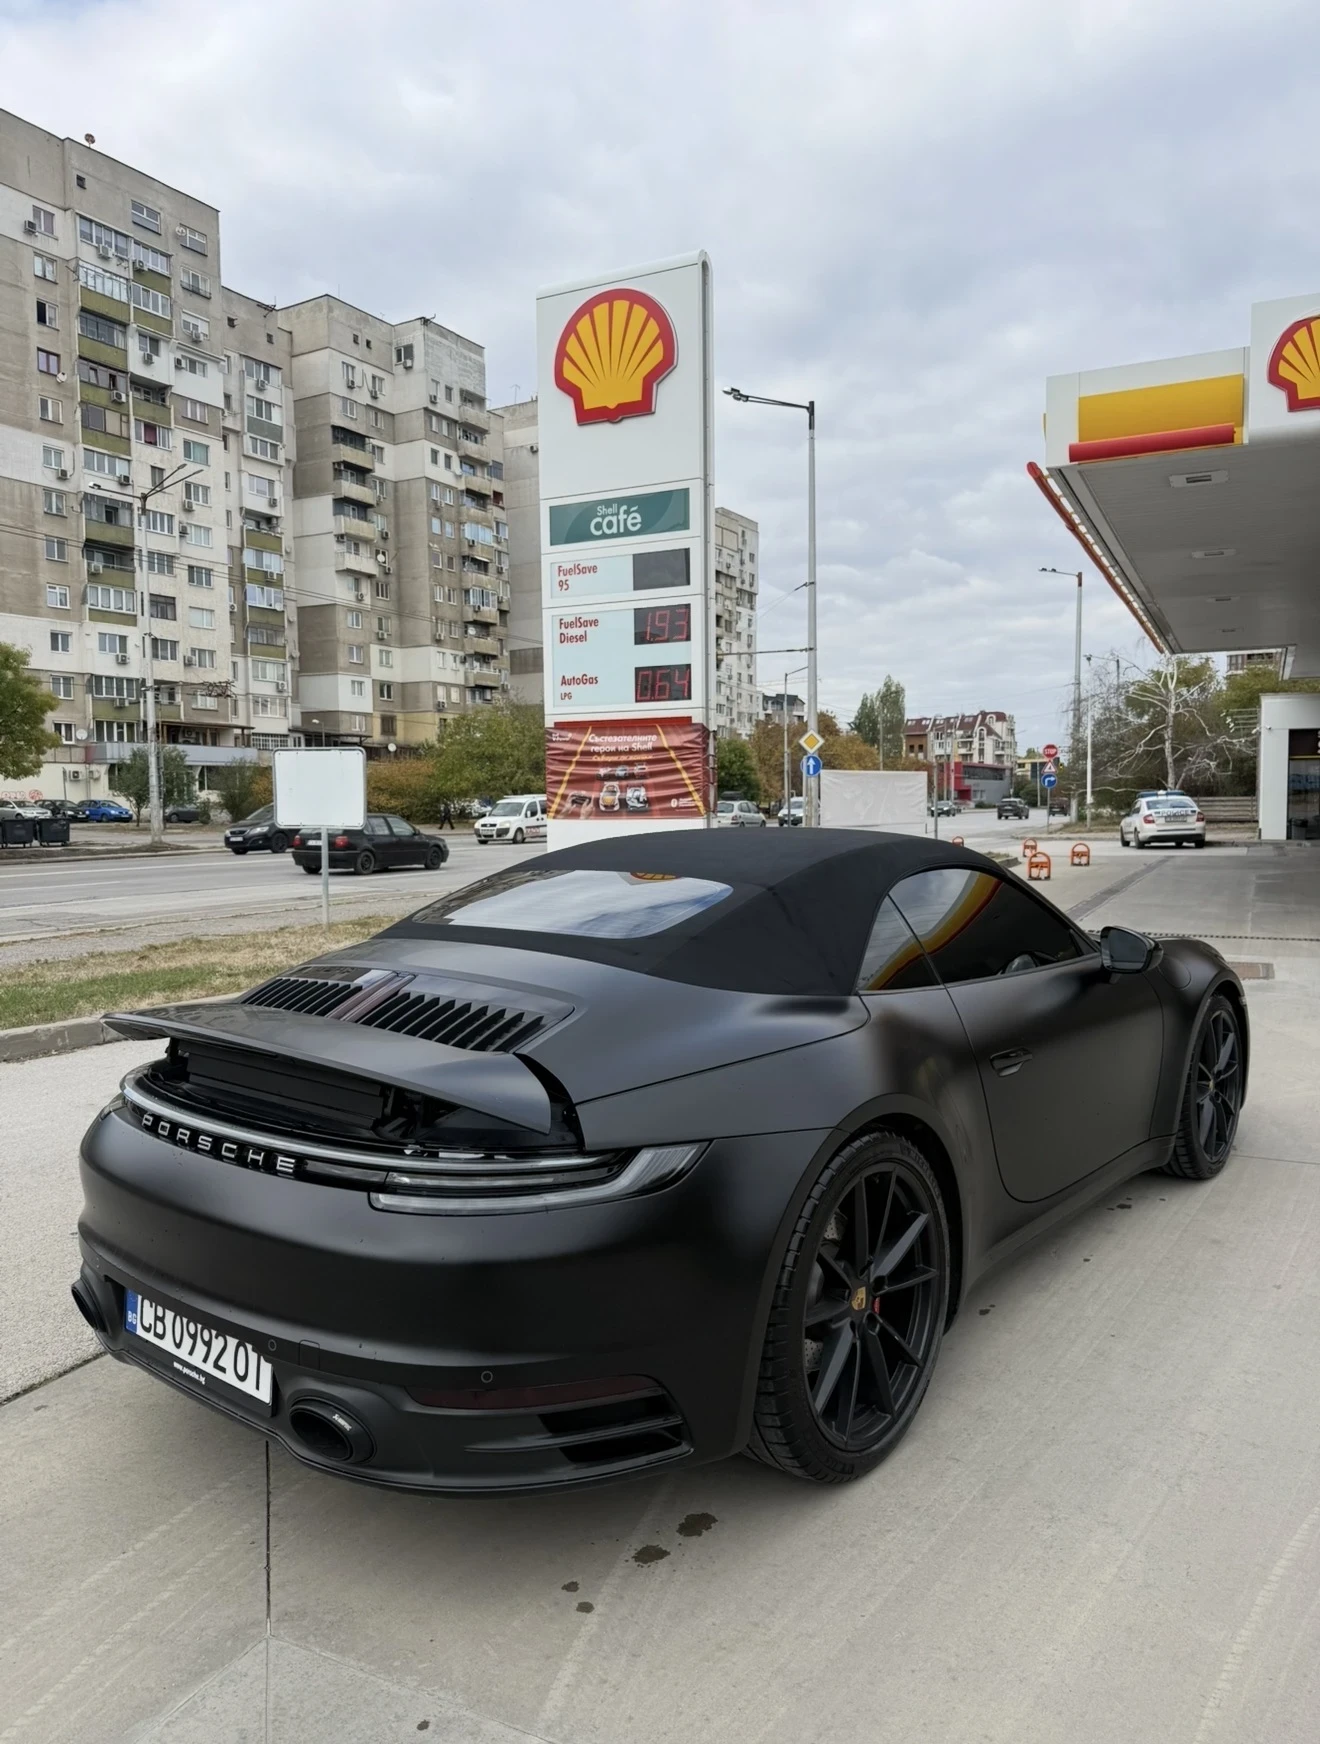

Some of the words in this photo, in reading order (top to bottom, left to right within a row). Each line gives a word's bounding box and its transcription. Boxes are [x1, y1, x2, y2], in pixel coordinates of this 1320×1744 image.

[597, 503, 618, 516] Shell
[590, 504, 642, 536] café
[557, 563, 598, 577] FuelSave
[558, 579, 570, 591] 95
[559, 616, 599, 630] FuelSave
[559, 631, 588, 644] Diesel
[560, 673, 599, 687] AutoGas
[560, 692, 573, 701] LPG
[588, 733, 658, 743] Състезателните
[617, 744, 629, 752] на
[631, 741, 653, 752] Shell
[141, 1113, 296, 1174] PORSCHE
[127, 1310, 137, 1325] BG
[172, 1313, 228, 1375] 0992
